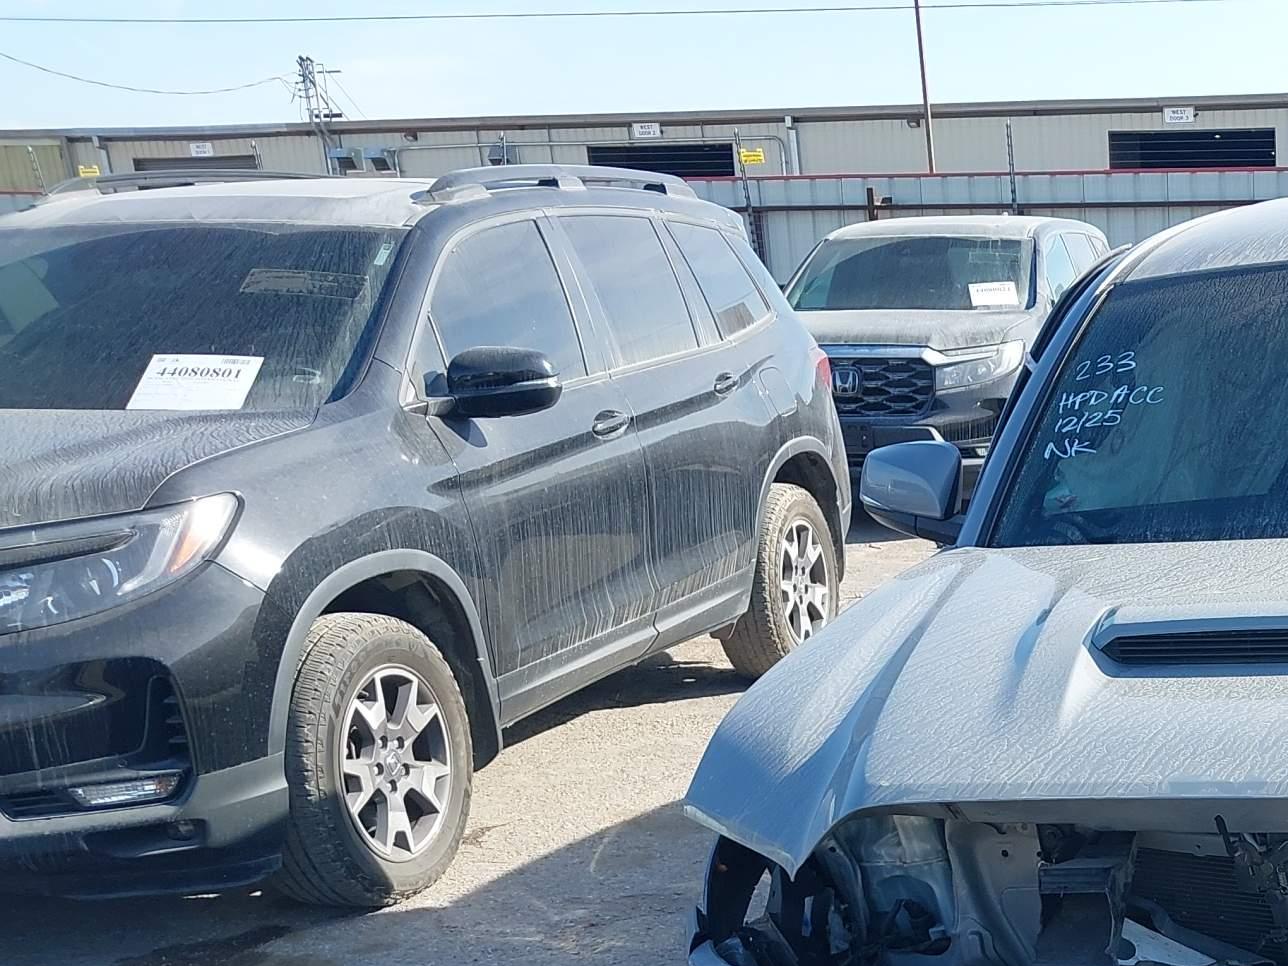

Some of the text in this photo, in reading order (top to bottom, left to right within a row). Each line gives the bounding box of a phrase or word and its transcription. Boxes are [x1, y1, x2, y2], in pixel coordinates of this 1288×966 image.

[156, 366, 241, 379] 44080801
[1076, 351, 1137, 381] 233
[1055, 409, 1122, 433] 12/25
